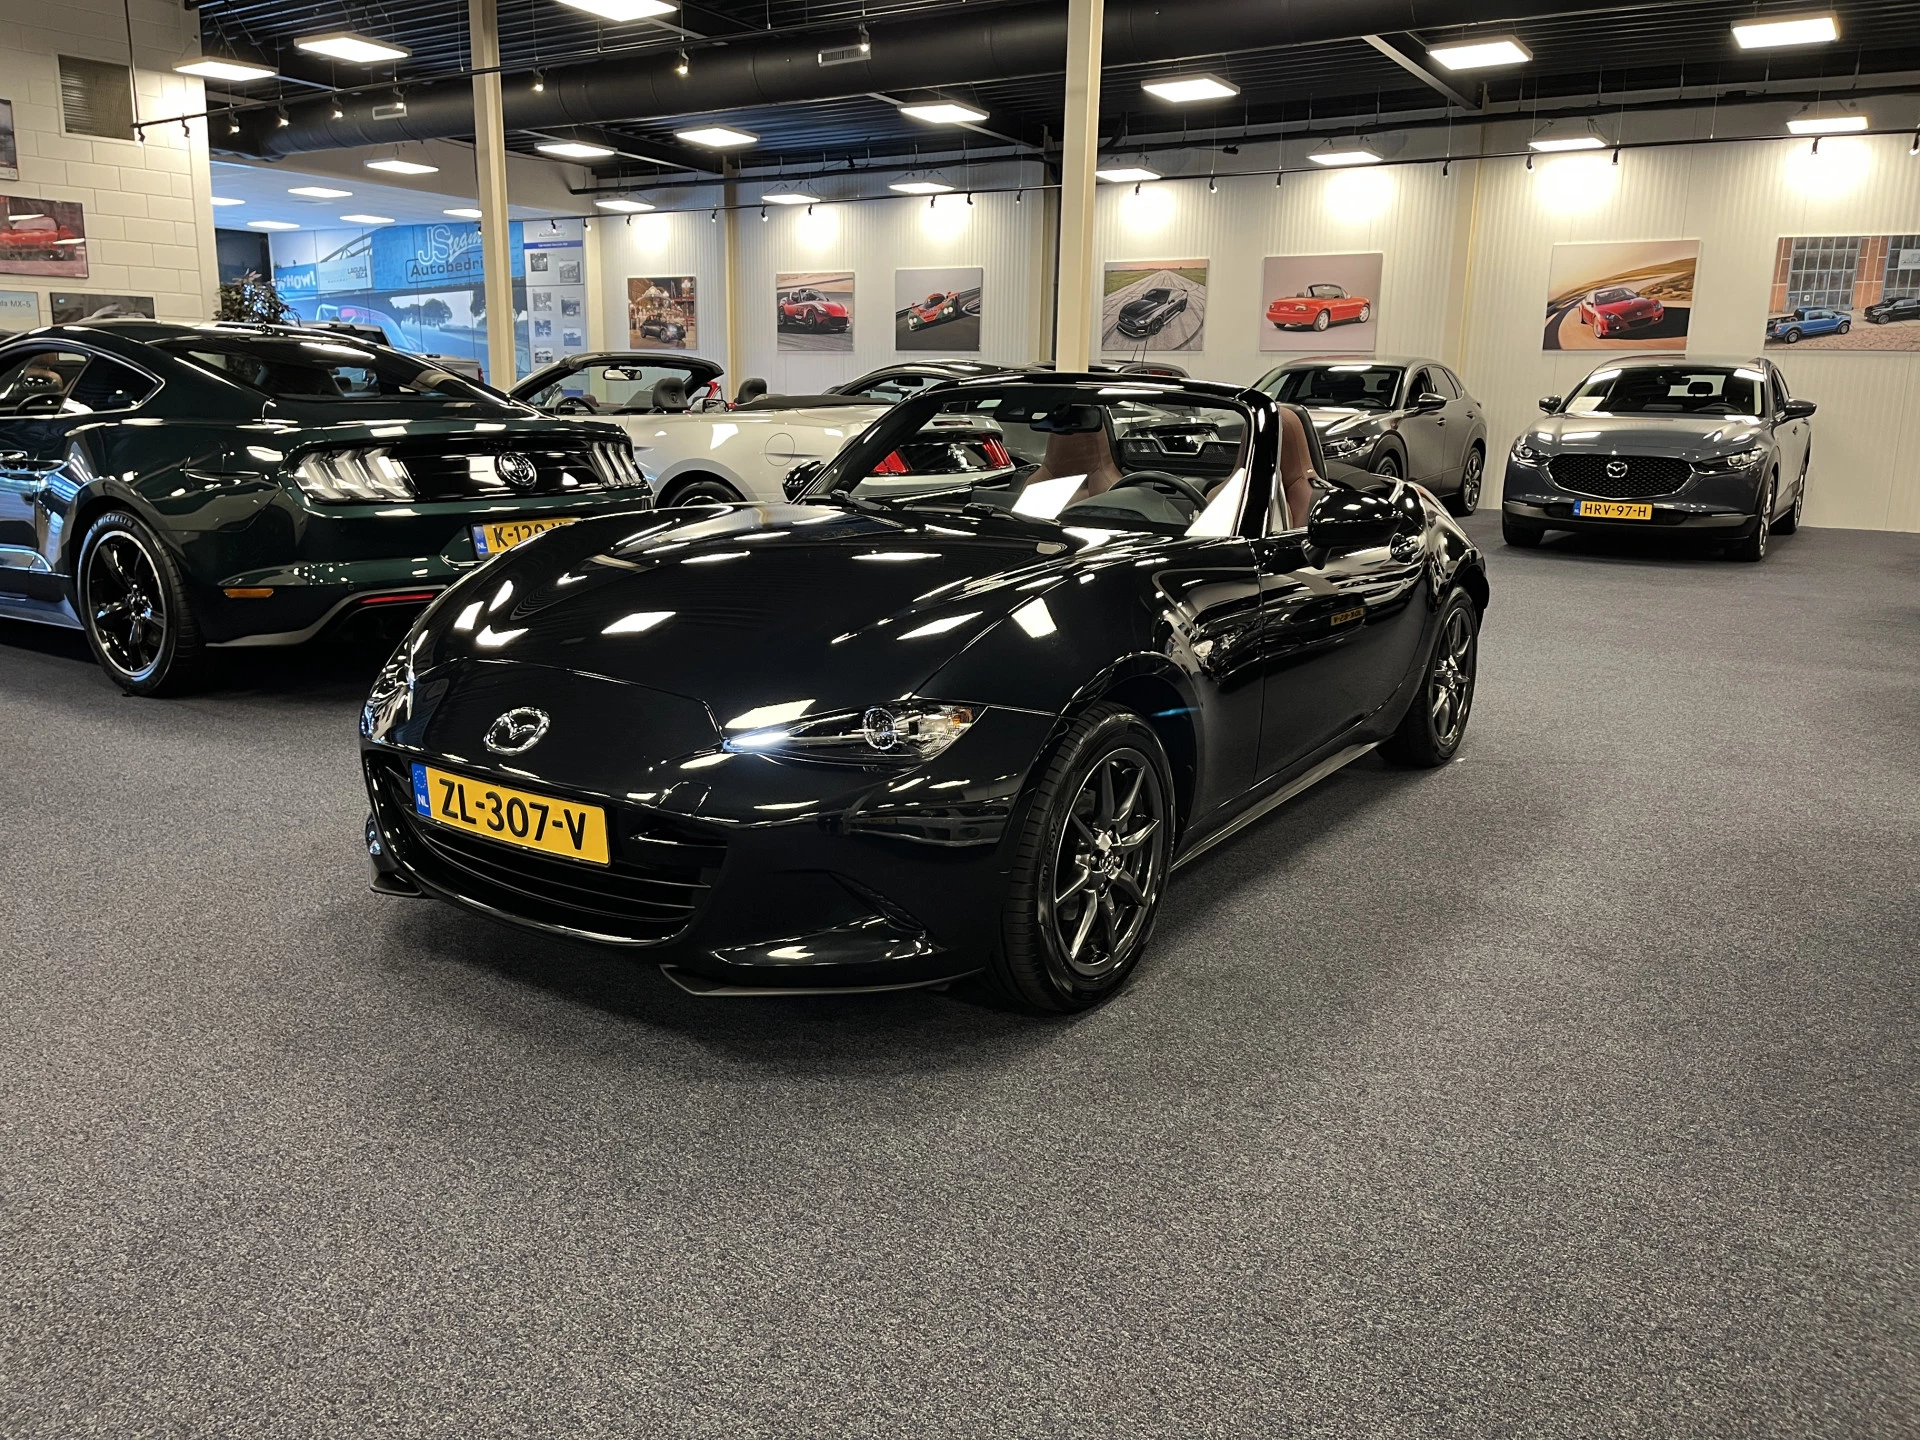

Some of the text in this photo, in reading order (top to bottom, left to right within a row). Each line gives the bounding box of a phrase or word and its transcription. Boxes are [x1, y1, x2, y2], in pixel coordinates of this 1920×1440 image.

[410, 256, 484, 277] Autobedri
[10, 299, 31, 308] MX-5
[1584, 503, 1647, 518] HRV-97-H
[477, 541, 487, 550] NL
[417, 793, 429, 808] NL
[438, 777, 587, 851] ZL-307-V
